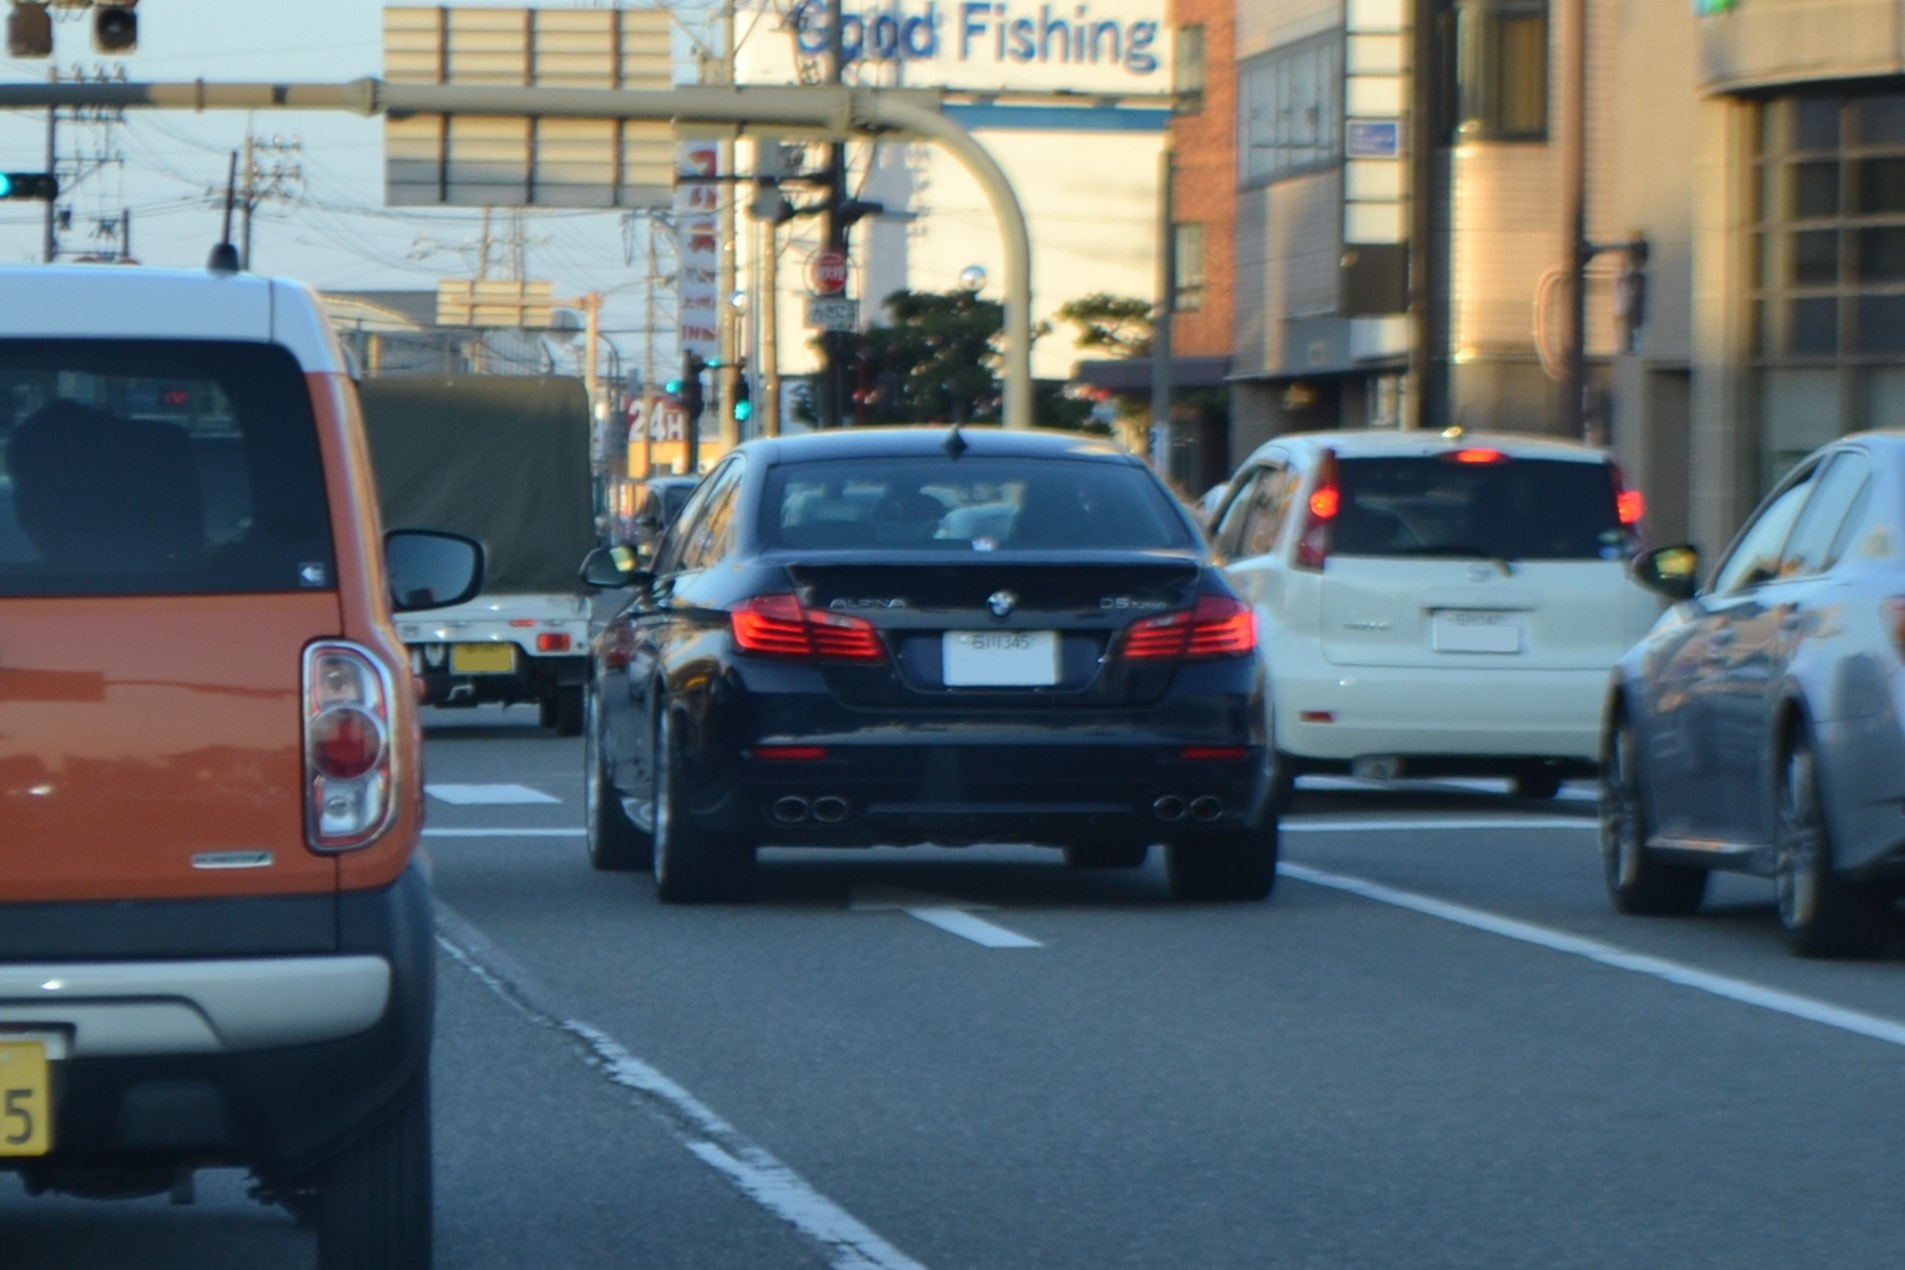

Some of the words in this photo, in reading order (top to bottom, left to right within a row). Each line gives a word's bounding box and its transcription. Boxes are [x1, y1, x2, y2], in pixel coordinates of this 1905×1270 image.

[797, 0, 936, 57] Good
[959, 2, 1158, 76] Fishing
[628, 398, 685, 442] 24H
[829, 598, 906, 609] ALPINA
[4, 1088, 33, 1146] 5
